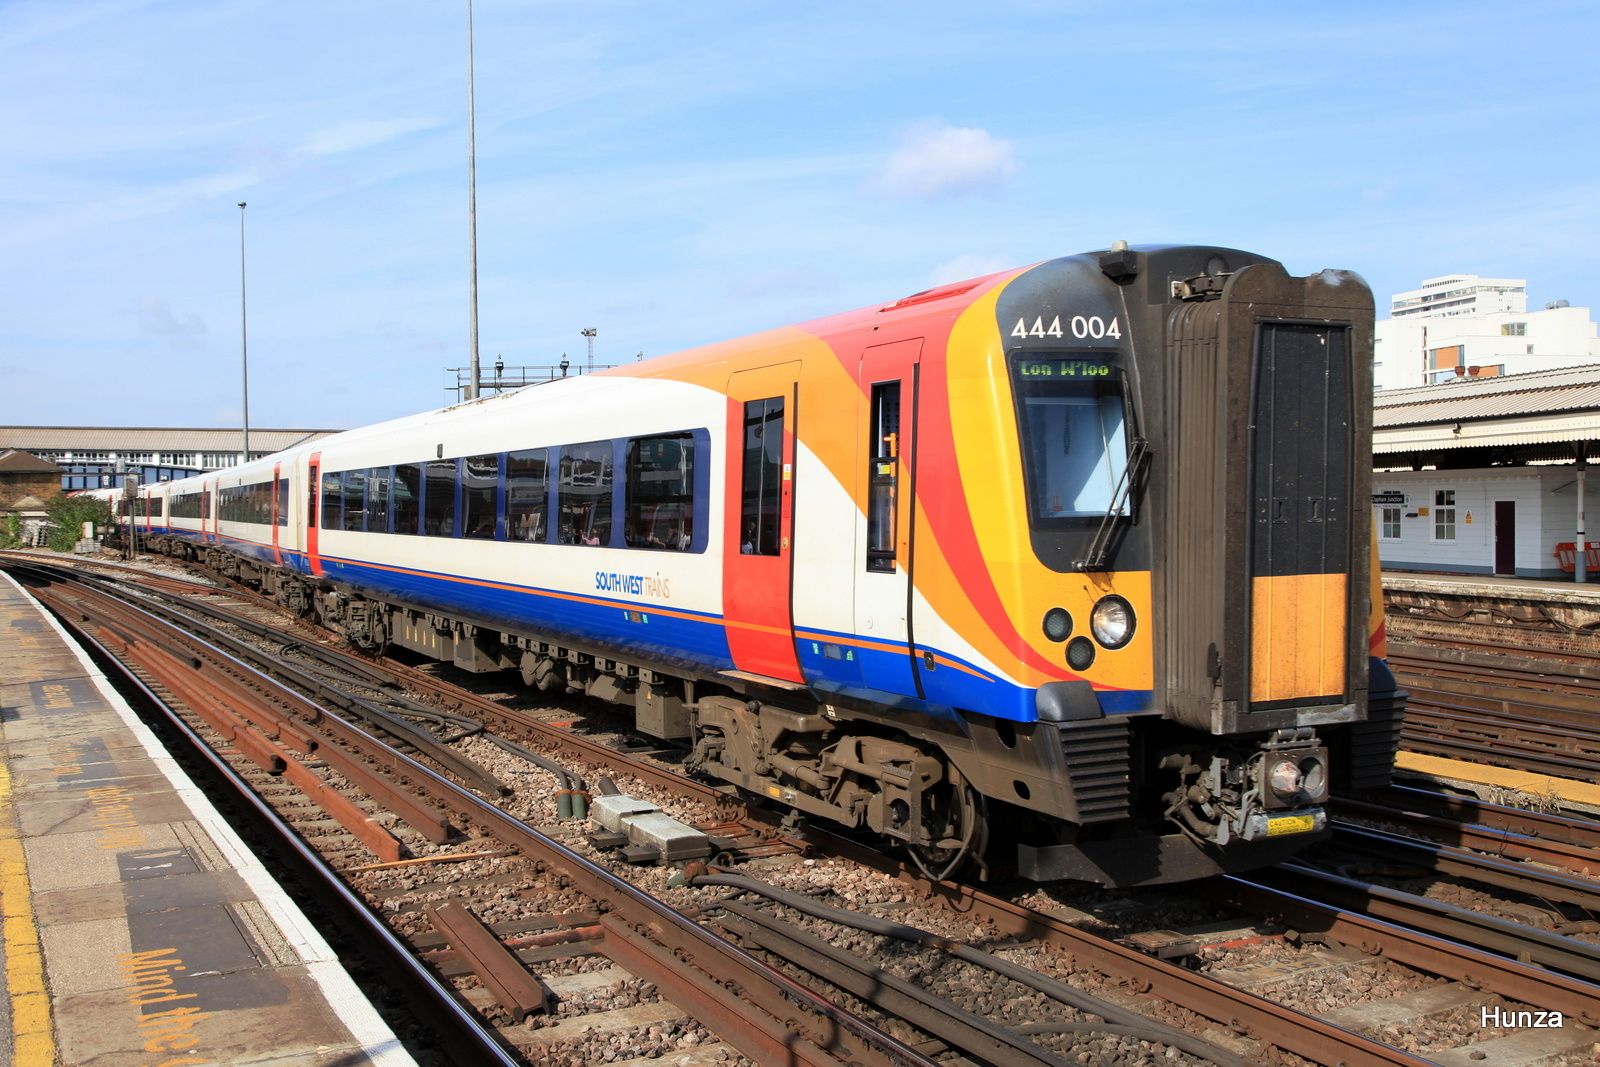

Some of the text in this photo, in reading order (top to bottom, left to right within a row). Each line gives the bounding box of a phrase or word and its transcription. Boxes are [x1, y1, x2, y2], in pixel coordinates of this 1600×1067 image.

[1010, 314, 1122, 340] 444 004
[1021, 360, 1052, 376] Lon
[595, 571, 670, 599] SOUTH WEST TRAINS
[114, 948, 198, 1005] Mind
[135, 1007, 209, 1053] the
